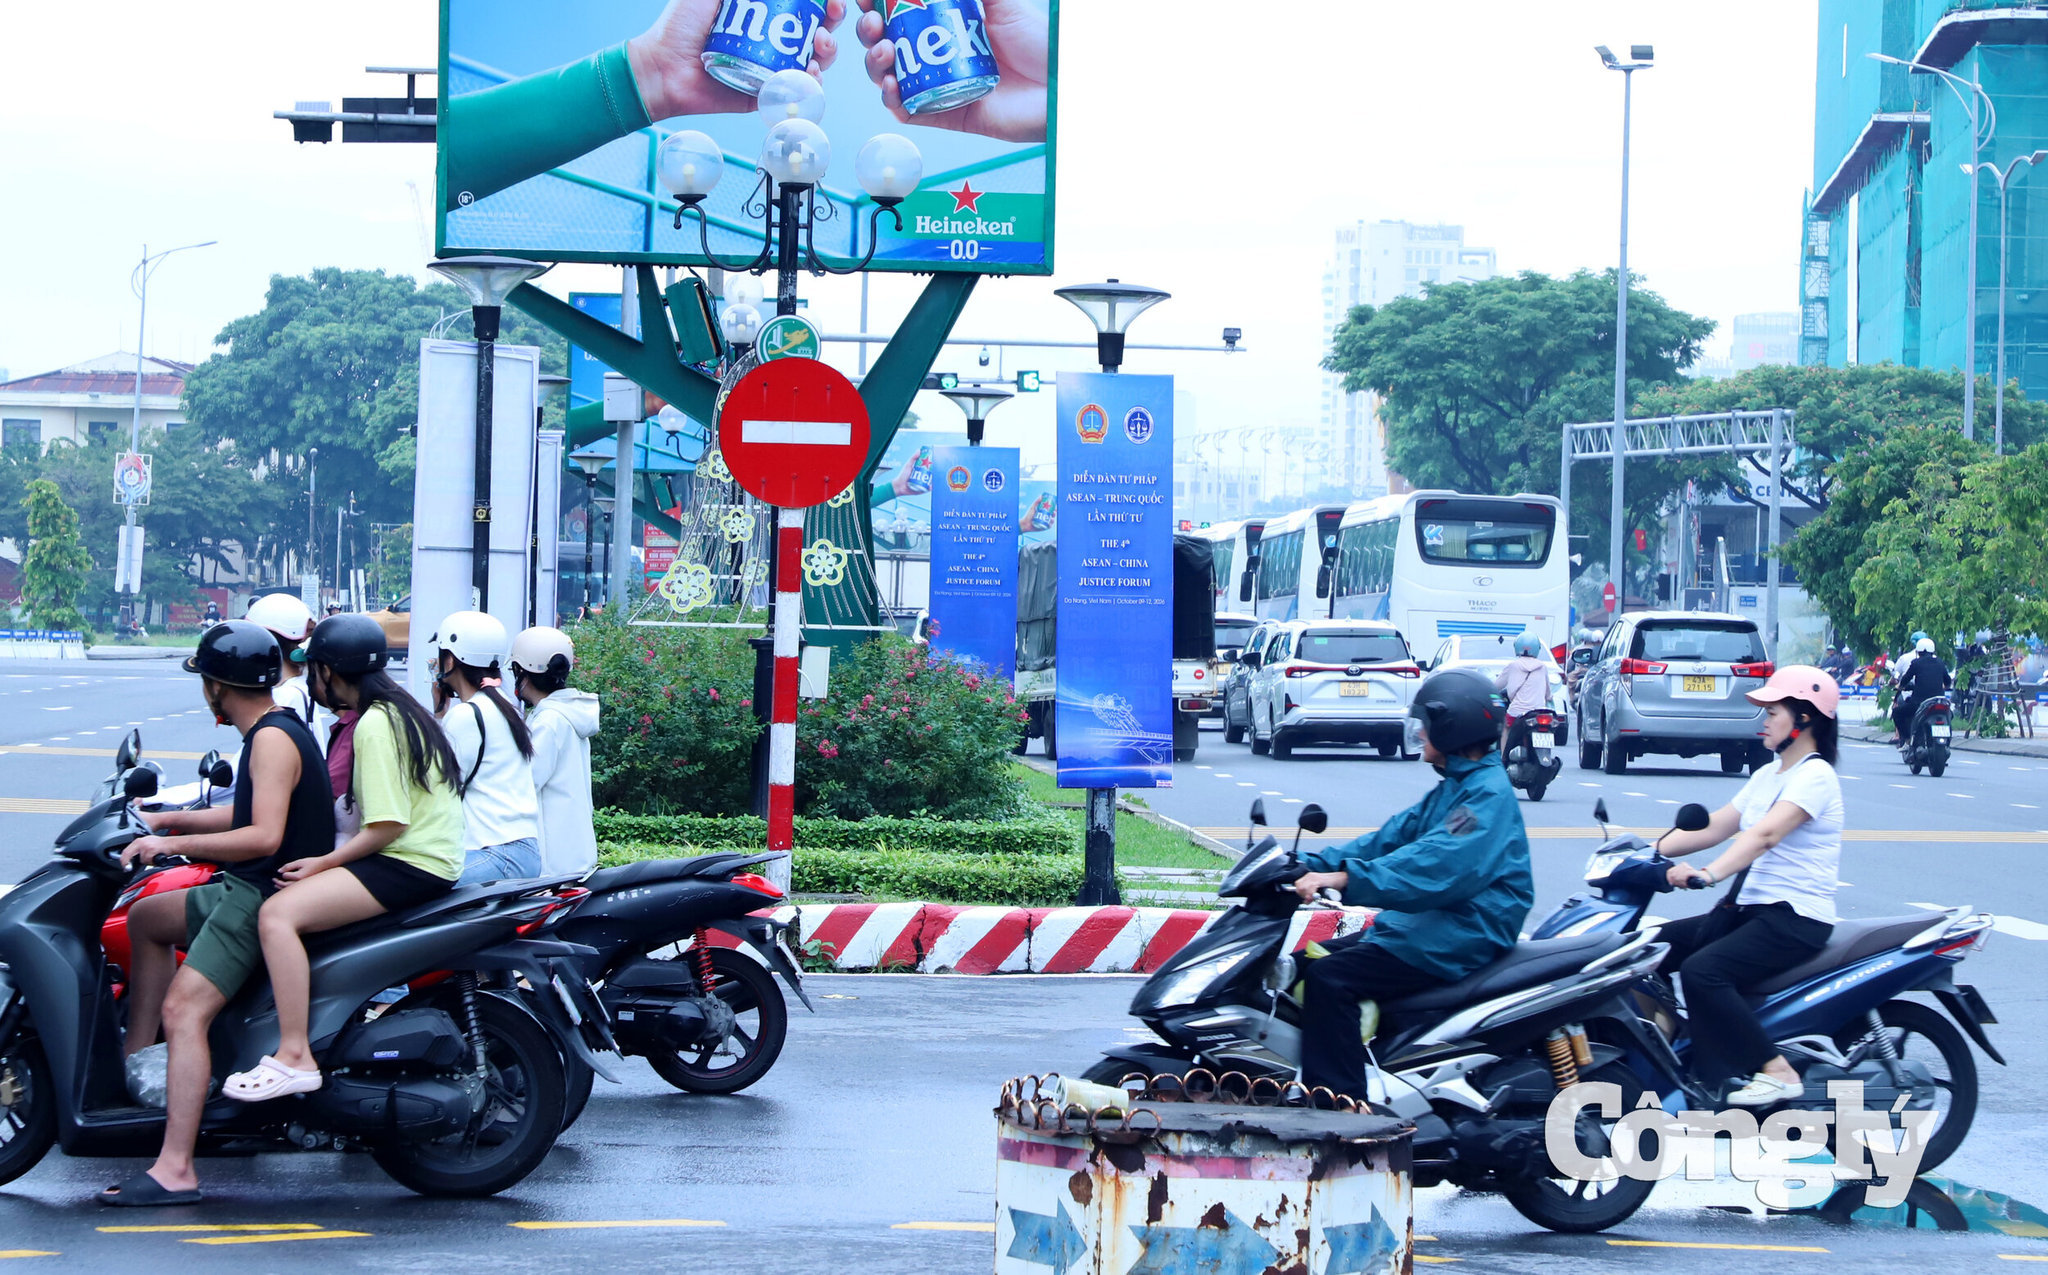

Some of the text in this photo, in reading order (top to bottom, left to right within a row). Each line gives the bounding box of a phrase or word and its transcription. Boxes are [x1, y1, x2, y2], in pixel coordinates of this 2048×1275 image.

[915, 216, 1015, 235] Heineken
[950, 239, 979, 260] 0.0
[1023, 373, 1039, 390] 16
[1073, 470, 1095, 483] DIỄN
[1118, 474, 1132, 484] TƯ
[1133, 474, 1157, 484] PHÁP
[1066, 493, 1096, 502] ASEAN
[1104, 494, 1136, 503] TRUNG
[1138, 490, 1164, 505] QUỐC
[1088, 508, 1106, 521] LẦN
[1130, 513, 1144, 522] TƯ
[1100, 539, 1119, 548] THE
[1081, 558, 1111, 567] ASEAN
[1119, 559, 1148, 568] CHINA
[1078, 577, 1151, 587] JUSTICE FORUM
[1467, 599, 1498, 607] THACO
